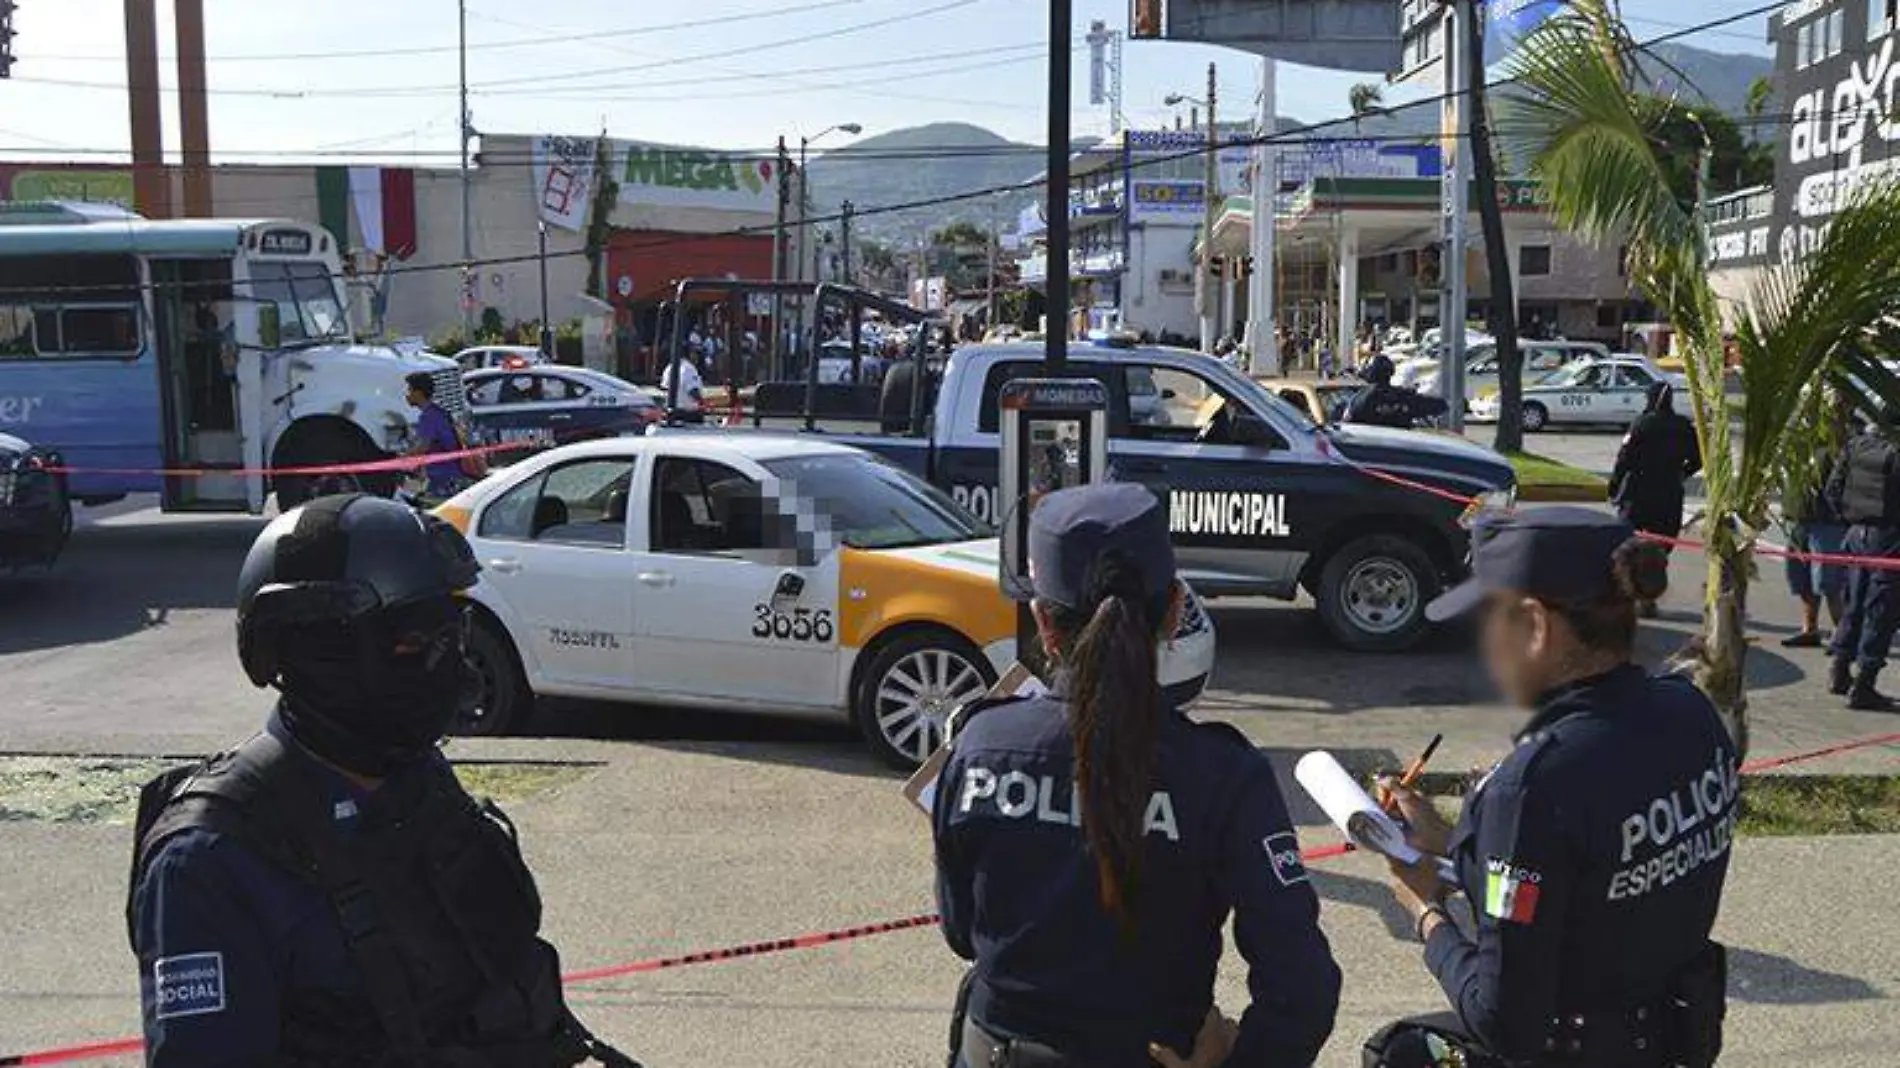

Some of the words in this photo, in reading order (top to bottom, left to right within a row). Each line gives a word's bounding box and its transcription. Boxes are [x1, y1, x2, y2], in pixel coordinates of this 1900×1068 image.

[625, 146, 740, 190] MEGA
[0, 396, 43, 424] er
[1034, 388, 1105, 404] MONEDAS
[952, 484, 1000, 530] POL
[1169, 489, 1291, 537] MUNICIPAL
[752, 603, 833, 643] 3656
[960, 767, 1180, 841] POLIA
[1607, 803, 1737, 900] ESPECIALIZ
